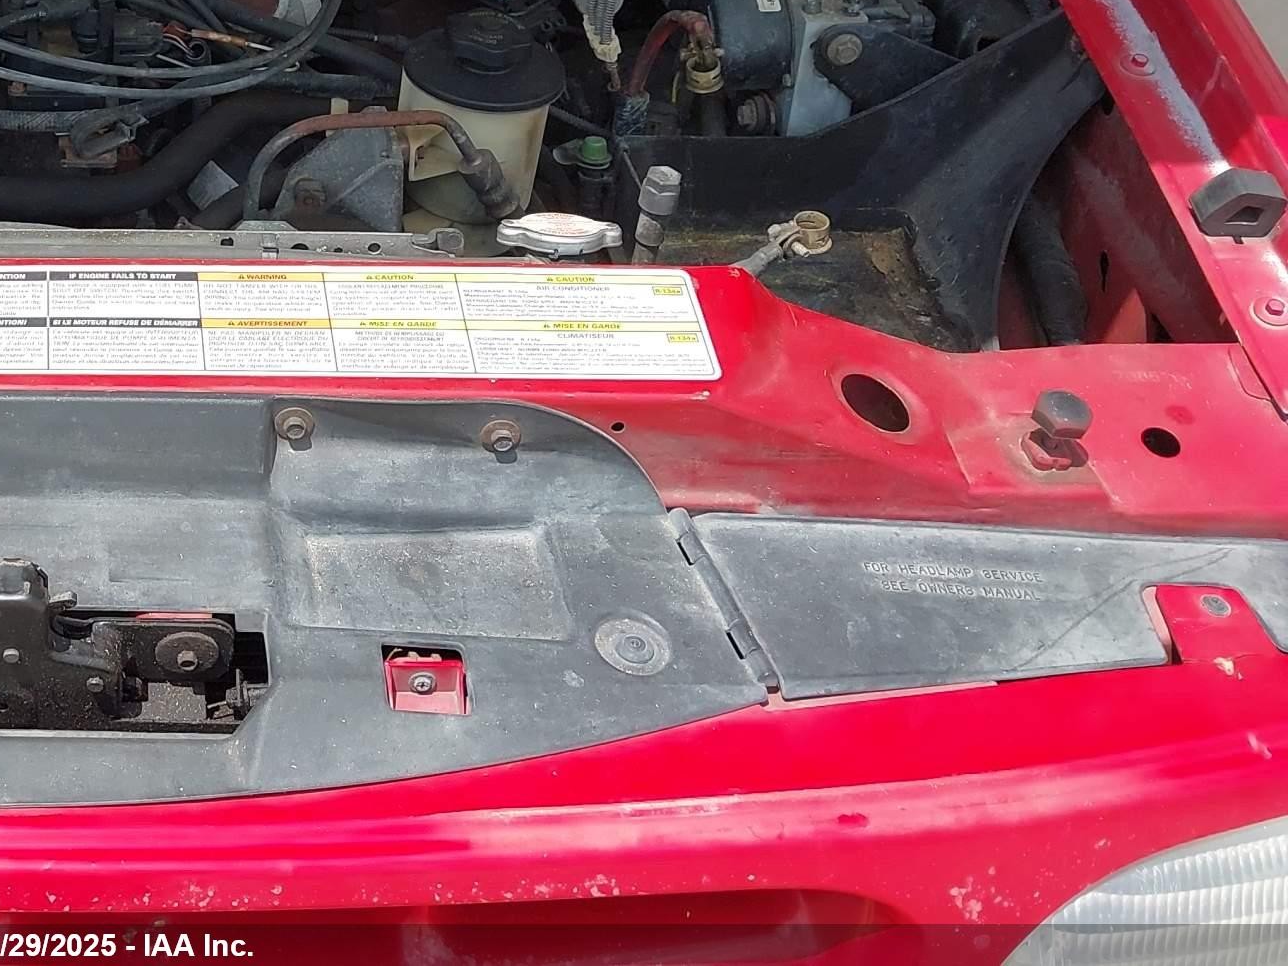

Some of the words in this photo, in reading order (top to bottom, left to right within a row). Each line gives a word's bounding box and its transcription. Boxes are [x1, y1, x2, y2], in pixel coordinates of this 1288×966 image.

[863, 562, 890, 573] FOR
[898, 564, 972, 578] HEADLAMP
[982, 569, 1044, 583] SERVICE
[881, 580, 910, 591] SEE
[918, 583, 975, 596] OWNERS
[982, 586, 1042, 601] MANUAL
